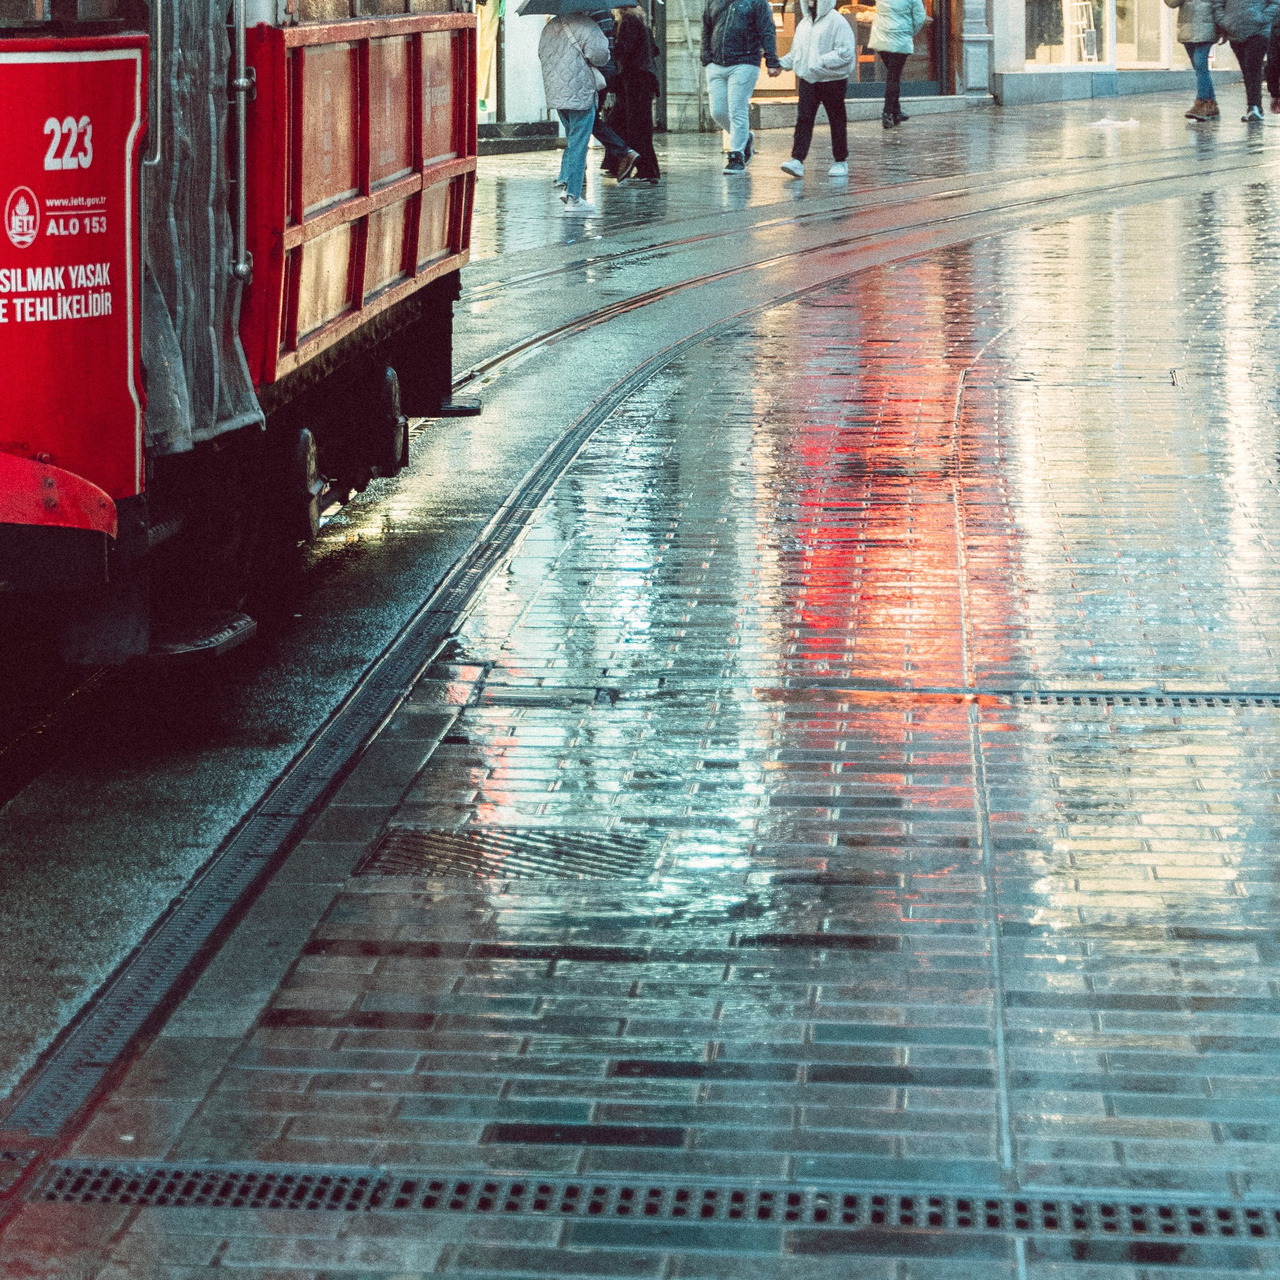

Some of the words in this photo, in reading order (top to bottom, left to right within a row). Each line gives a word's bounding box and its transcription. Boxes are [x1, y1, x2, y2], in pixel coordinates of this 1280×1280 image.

[44, 116, 94, 170] 223
[45, 196, 107, 208] www.iett.gov.tr
[46, 219, 80, 236] ALO
[84, 217, 107, 234] 153
[68, 262, 111, 289] YASAK
[12, 288, 112, 322] TEHLİKELİDİR
